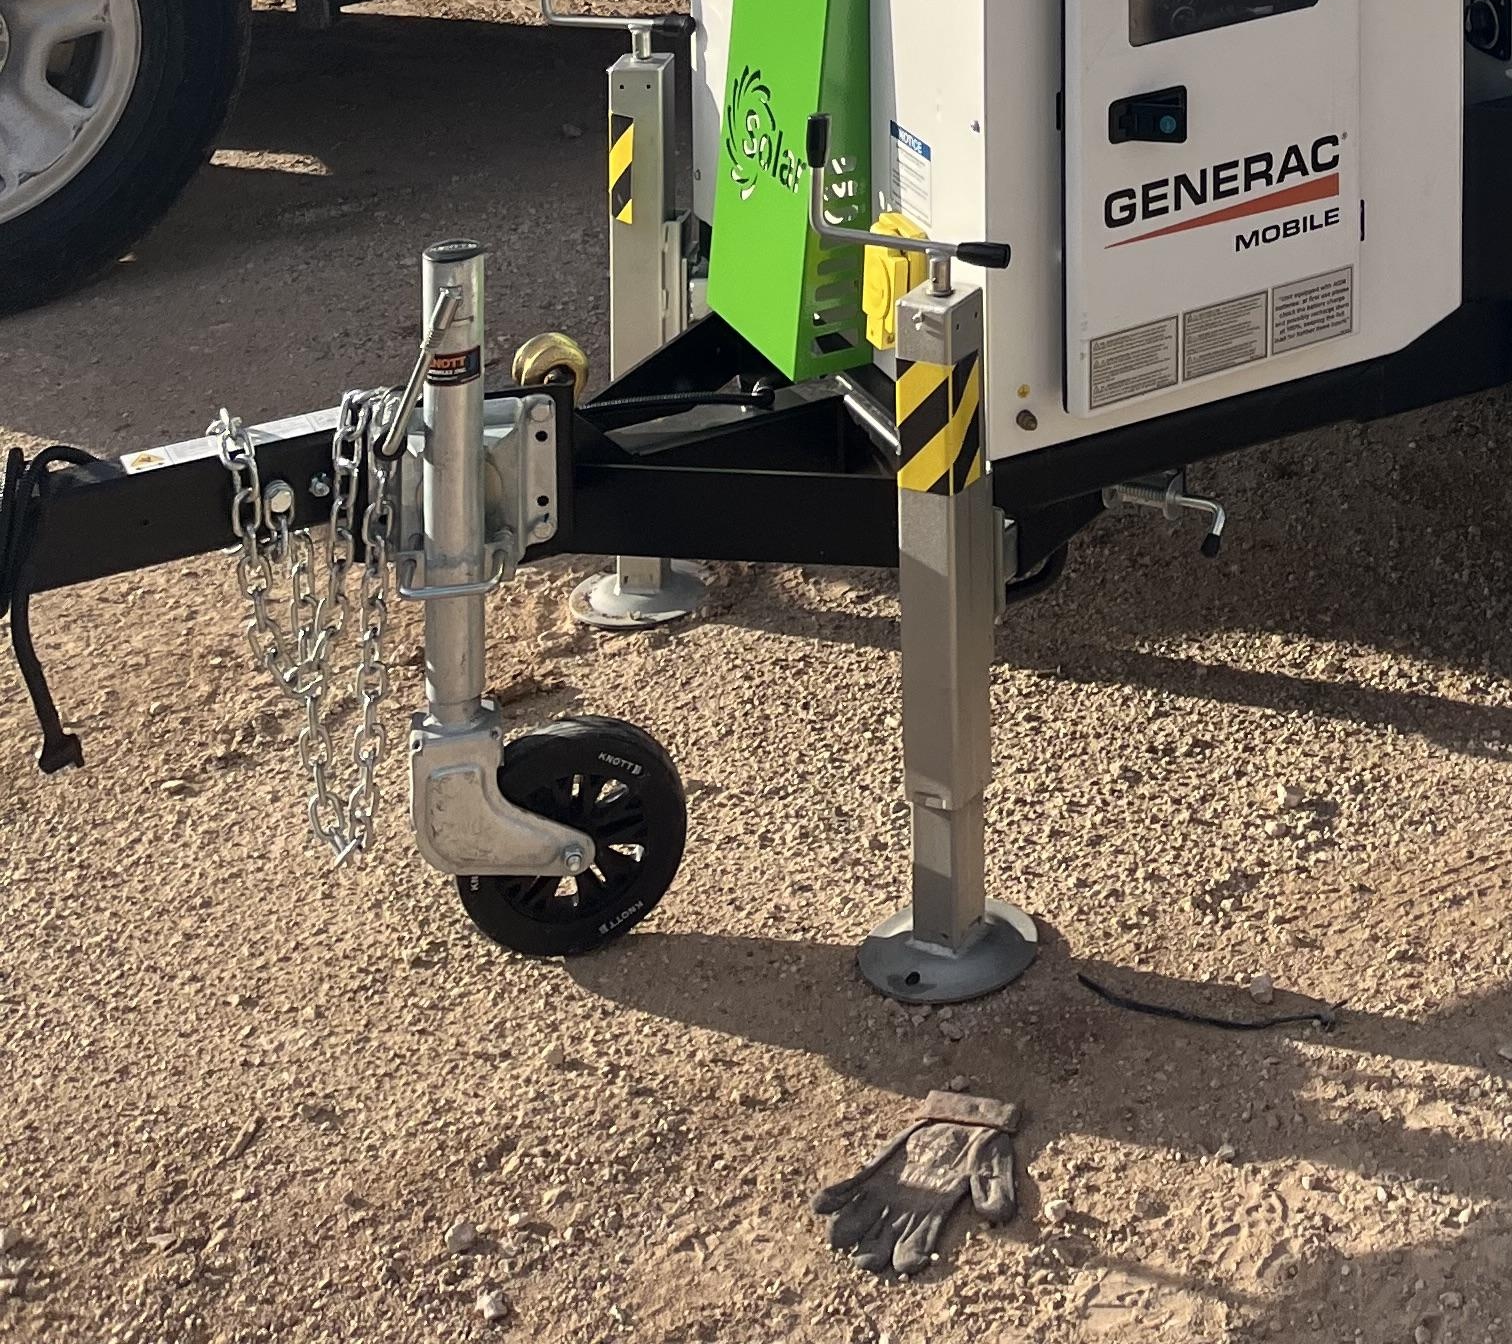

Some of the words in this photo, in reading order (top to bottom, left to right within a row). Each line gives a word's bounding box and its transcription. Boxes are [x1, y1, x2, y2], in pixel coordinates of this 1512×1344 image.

[742, 109, 808, 194] Solar
[898, 127, 924, 155] NOTICE
[1103, 134, 1341, 229] GENERAC
[1235, 207, 1341, 253] MOBILE
[429, 357, 467, 368] NOTT
[598, 751, 633, 772] KNOTT
[608, 900, 645, 930] KNOTT
